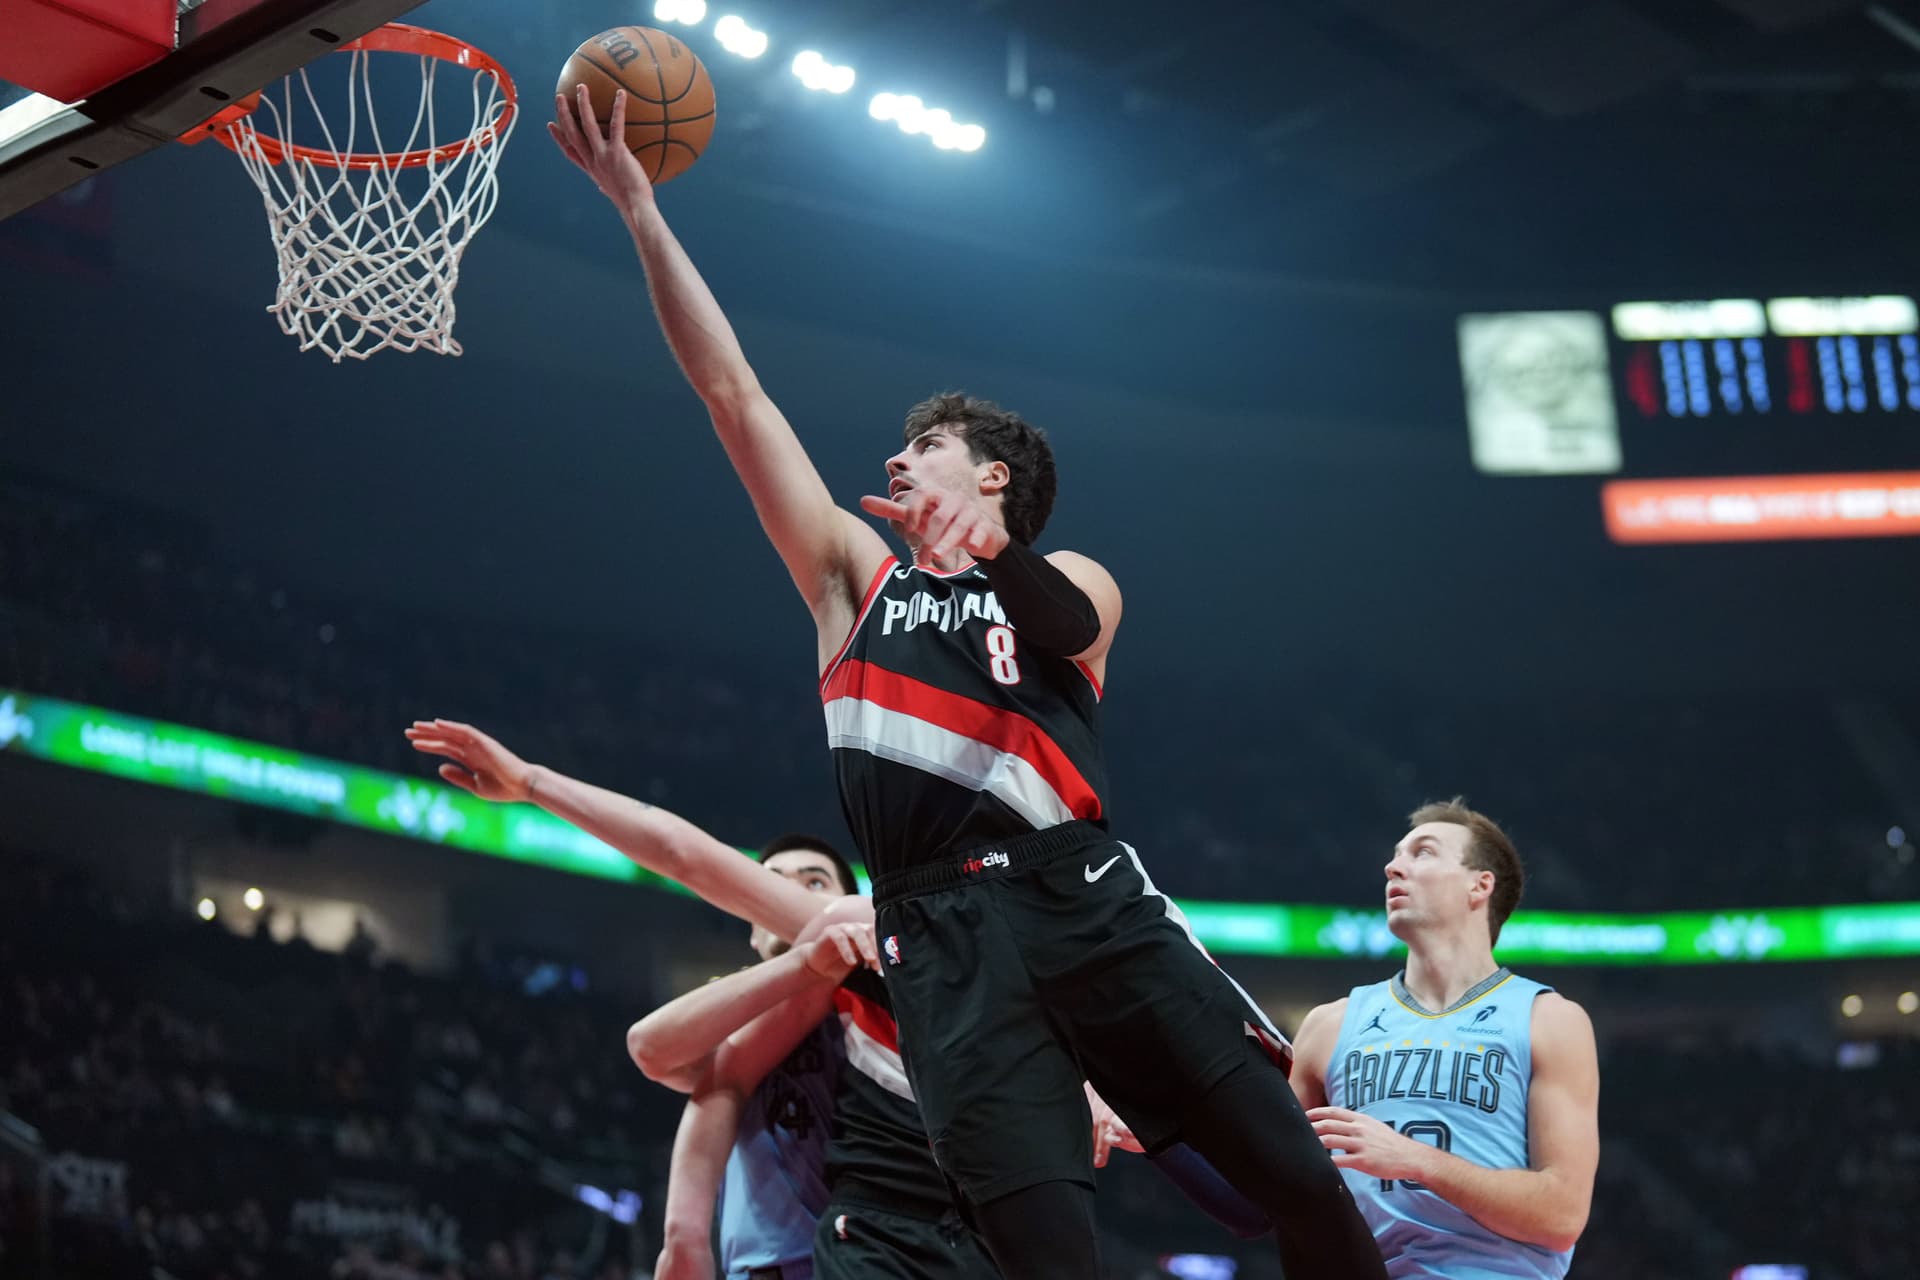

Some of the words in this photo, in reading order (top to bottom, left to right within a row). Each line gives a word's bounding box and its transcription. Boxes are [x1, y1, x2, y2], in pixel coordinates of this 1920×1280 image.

[882, 587, 1016, 635] PORTLAN
[985, 625, 1021, 685] 8
[1345, 1048, 1504, 1114] GRIZZLIES
